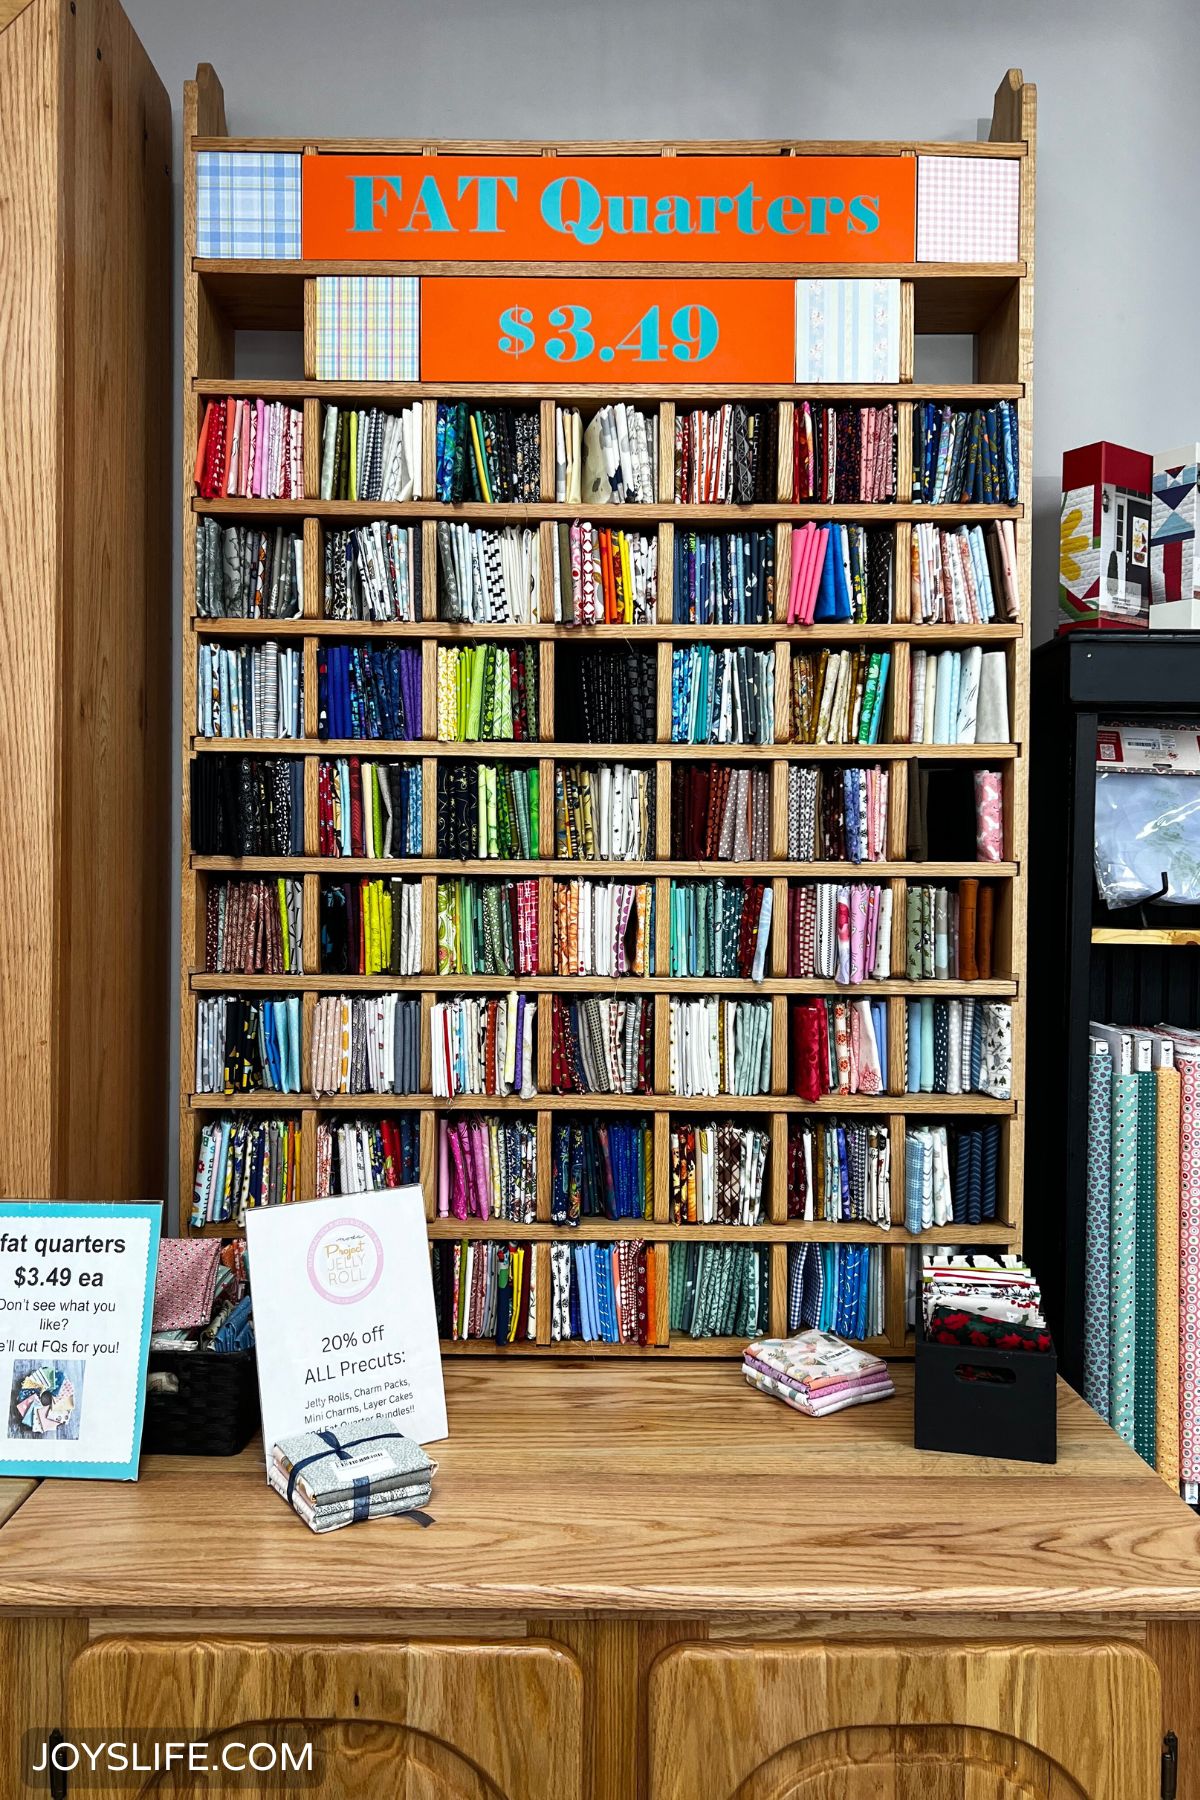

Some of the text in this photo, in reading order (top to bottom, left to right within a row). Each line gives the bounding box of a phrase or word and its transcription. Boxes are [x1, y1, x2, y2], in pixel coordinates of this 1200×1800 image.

[347, 175, 880, 245] FAT Quarters
[498, 304, 720, 363] $3.49
[0, 1233, 126, 1258] fat quarters
[324, 1241, 366, 1260] Project
[328, 1254, 366, 1271] JELLY
[14, 1265, 104, 1289] $3.49 ea
[329, 1268, 367, 1286] ROLL
[0, 1298, 116, 1315] Don't see what you
[39, 1318, 69, 1331] like?
[18, 1340, 38, 1353] cut
[41, 1340, 68, 1353] FQs
[72, 1341, 90, 1353] for
[92, 1341, 120, 1357] you!
[321, 1324, 385, 1353] 20% off
[304, 1351, 406, 1385] ALL Precuts:
[305, 1378, 411, 1410] Jelly Rolls, Charm Packs,
[304, 1391, 414, 1425] Mini Charms, Layer Cakes
